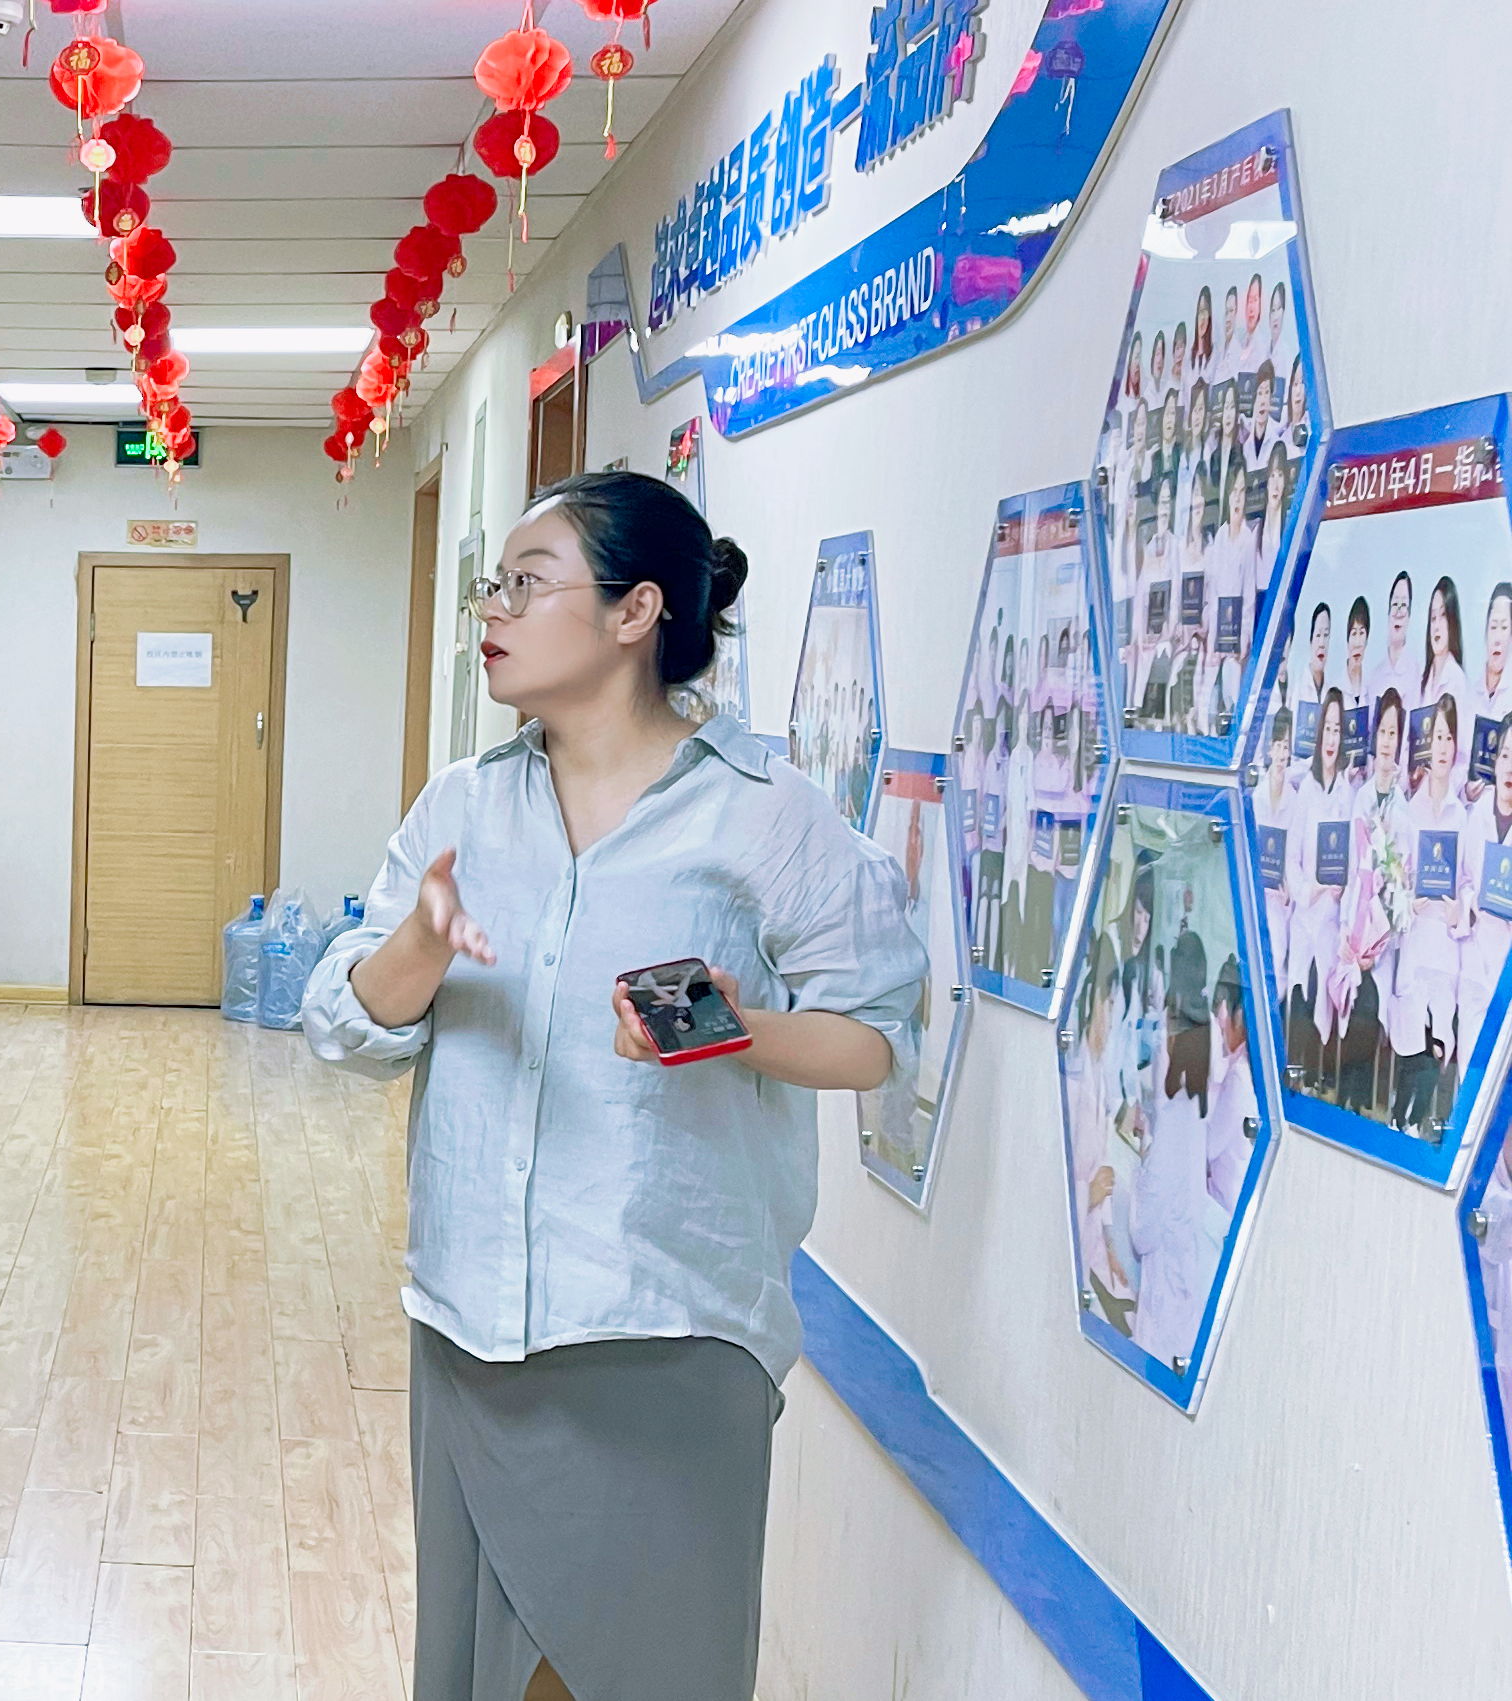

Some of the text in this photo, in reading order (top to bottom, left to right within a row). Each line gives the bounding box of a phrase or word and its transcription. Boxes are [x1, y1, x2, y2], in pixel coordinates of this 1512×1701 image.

[70, 48, 90, 70] 福
[600, 51, 624, 75] 福
[869, 246, 935, 337] BRAND
